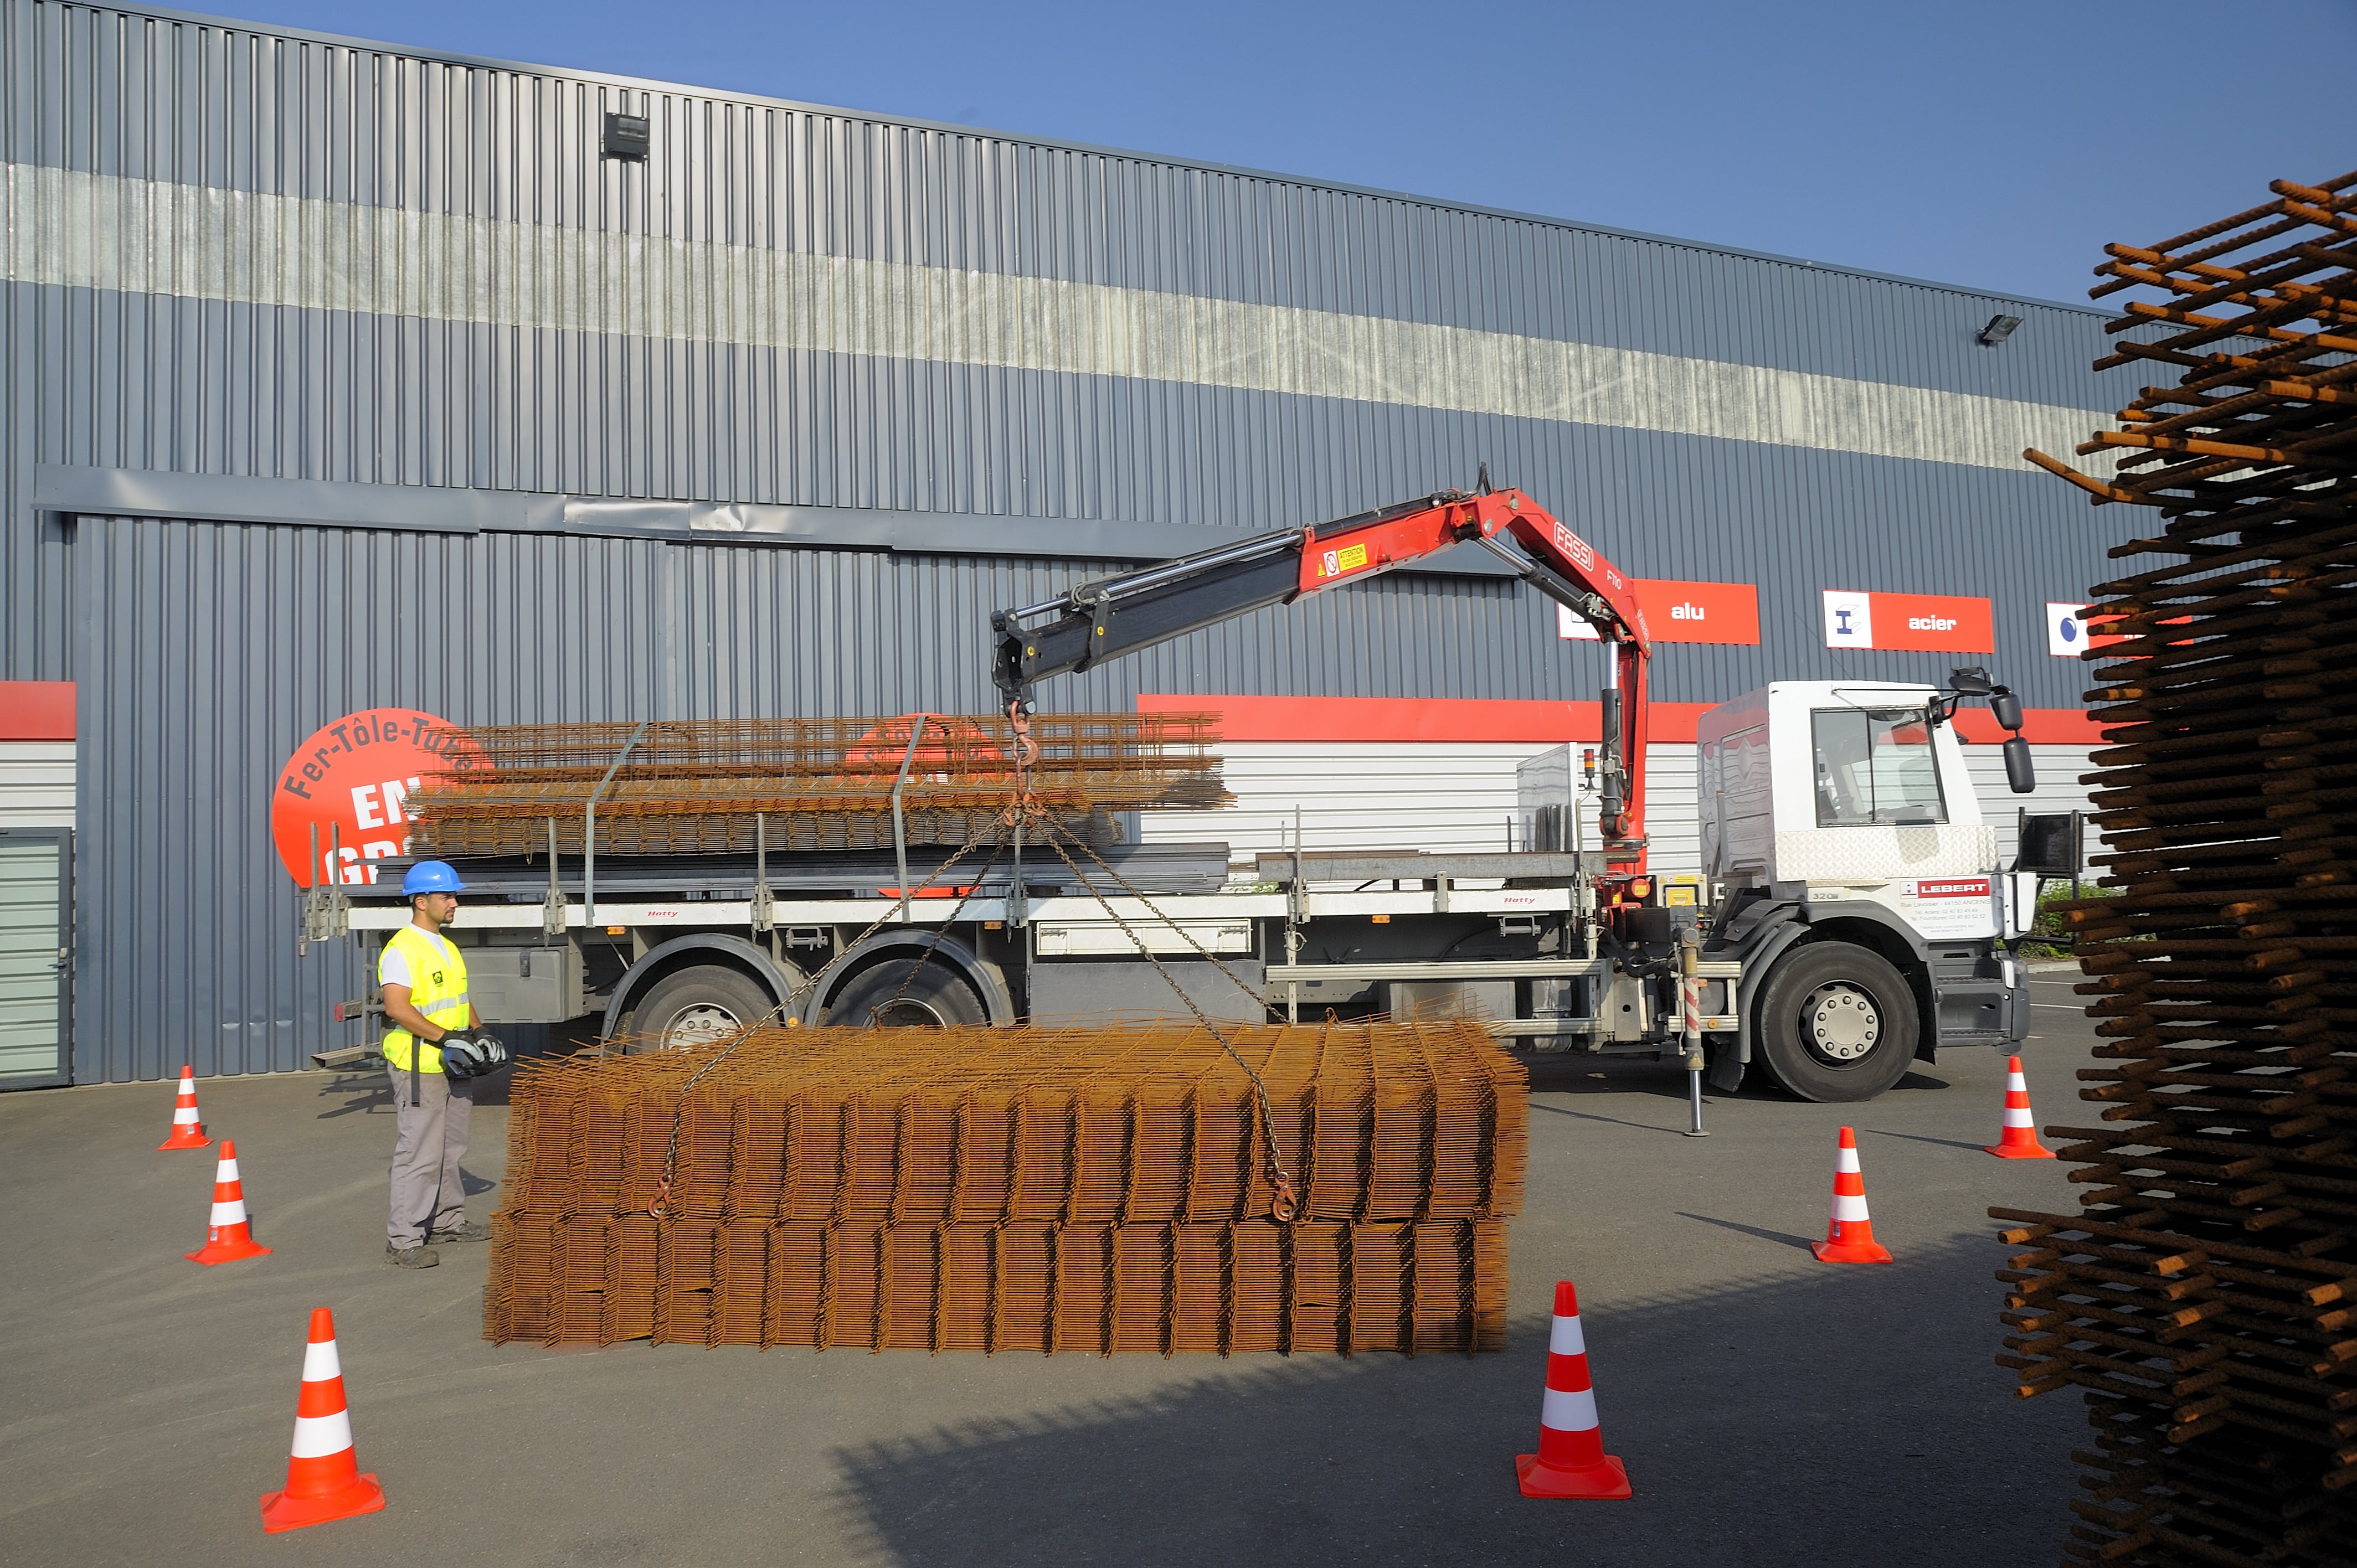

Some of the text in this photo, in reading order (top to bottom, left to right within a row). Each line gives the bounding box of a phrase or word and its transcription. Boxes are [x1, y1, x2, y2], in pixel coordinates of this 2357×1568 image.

[1557, 526, 1591, 568] FASSI
[1607, 569, 1622, 590] F110
[1671, 602, 1705, 620] alu
[1908, 614, 1957, 631] acier
[1921, 884, 1987, 894] LEBERT
